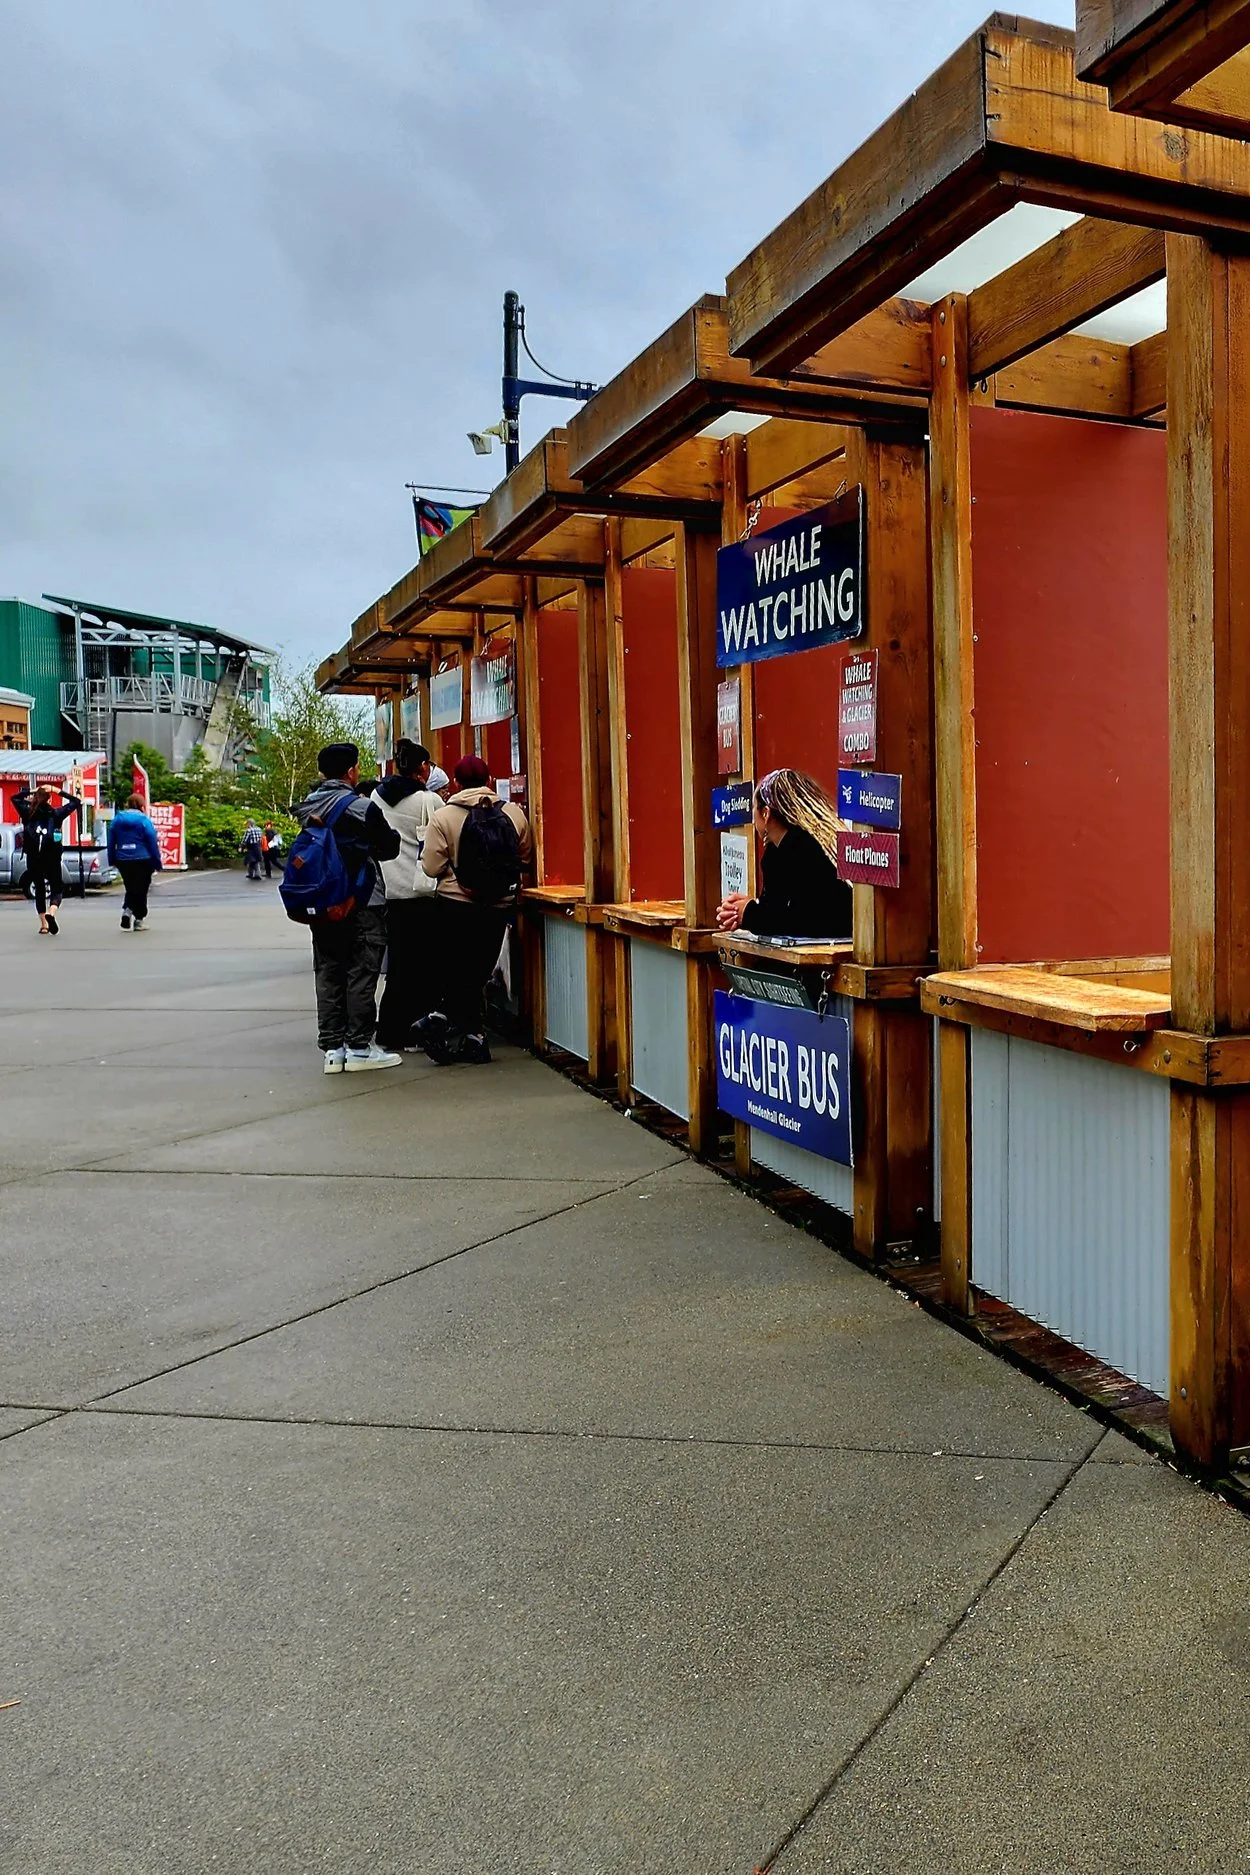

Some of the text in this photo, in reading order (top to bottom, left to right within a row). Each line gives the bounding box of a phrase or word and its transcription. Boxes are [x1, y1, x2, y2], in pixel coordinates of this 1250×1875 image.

[755, 524, 823, 587] WHALE
[720, 567, 854, 654] WATCHING
[845, 662, 872, 685] WHALE
[842, 684, 873, 705] WATCHING
[847, 704, 872, 723] GLACIER
[843, 732, 869, 753] COMBO
[721, 798, 750, 815] Dog Sledding
[859, 790, 894, 813] Helicopter
[845, 845, 889, 868] Float Planes
[725, 861, 742, 883] Trolley
[720, 1022, 839, 1120] GLACIER BUS
[747, 1099, 801, 1133] Mendenhall Glacier
